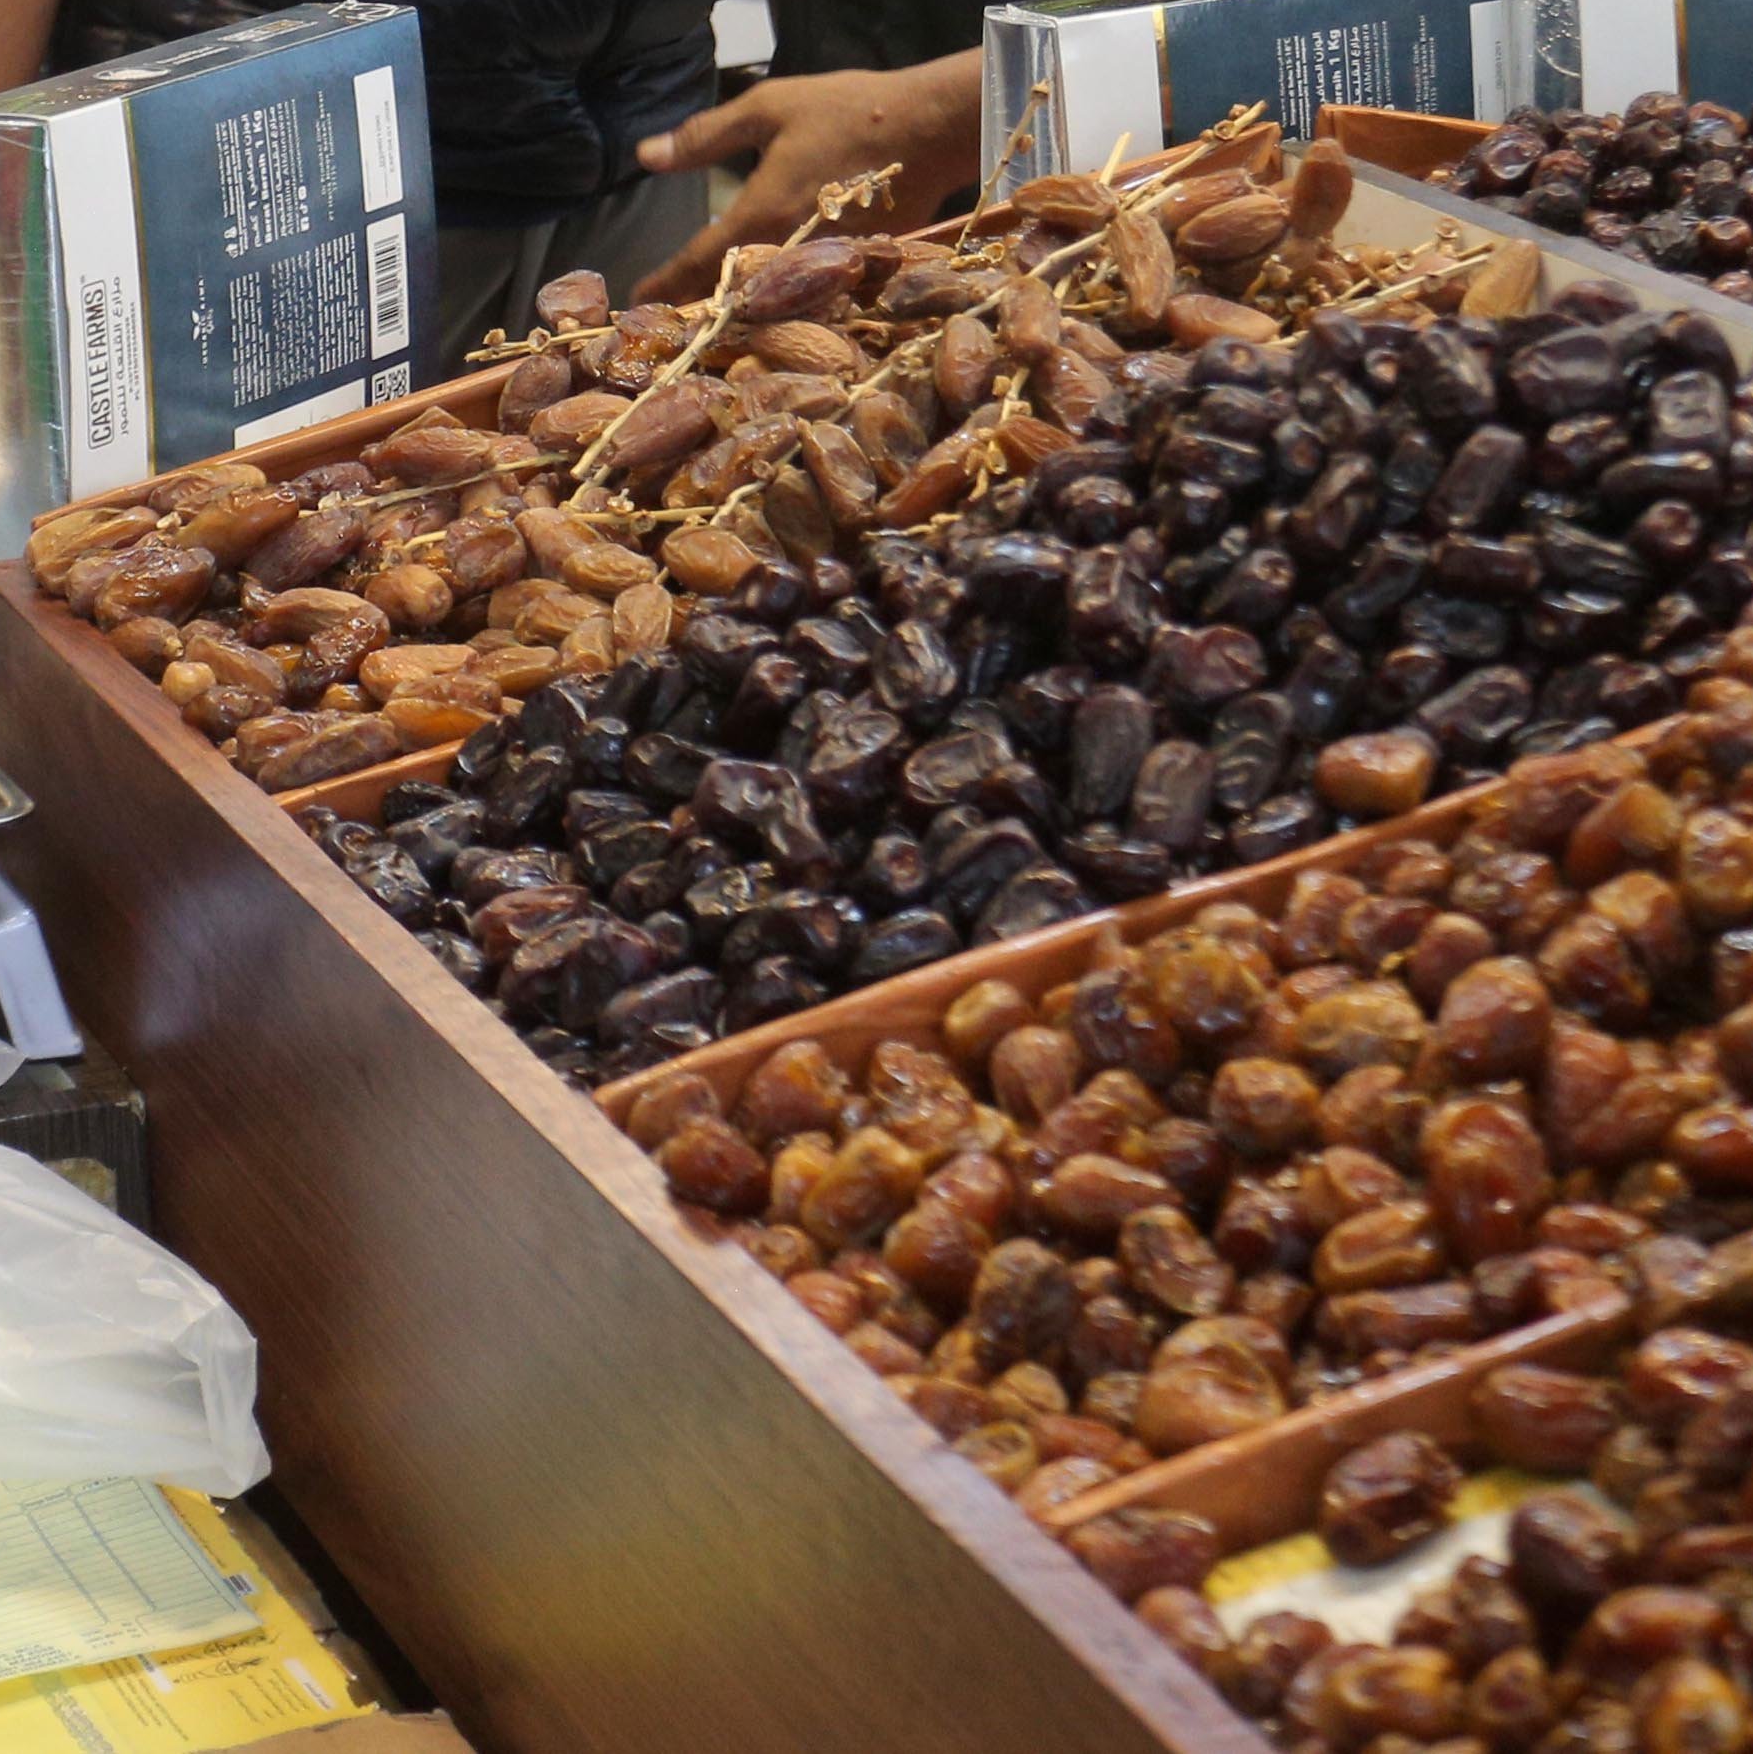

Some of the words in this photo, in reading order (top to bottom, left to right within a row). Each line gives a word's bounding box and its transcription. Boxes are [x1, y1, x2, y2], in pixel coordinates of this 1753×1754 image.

[1312, 32, 1324, 62] الوزن
[1327, 29, 1341, 50] Kg
[1329, 56, 1340, 65] 1
[1361, 23, 1373, 93] AlMunawara
[1333, 70, 1343, 104] ersih
[241, 113, 252, 144] الوزن
[251, 109, 263, 133] Kg
[276, 102, 289, 175] AlMunawara
[255, 140, 264, 148] 1
[245, 148, 259, 195] الصافي
[258, 153, 270, 199] Bersih
[262, 203, 273, 243] Berat
[111, 276, 124, 318] مزارع
[84, 288, 107, 359] FARMS
[113, 324, 126, 380] القلعة
[88, 362, 111, 442] CASTLE
[117, 384, 129, 436] للتمور
